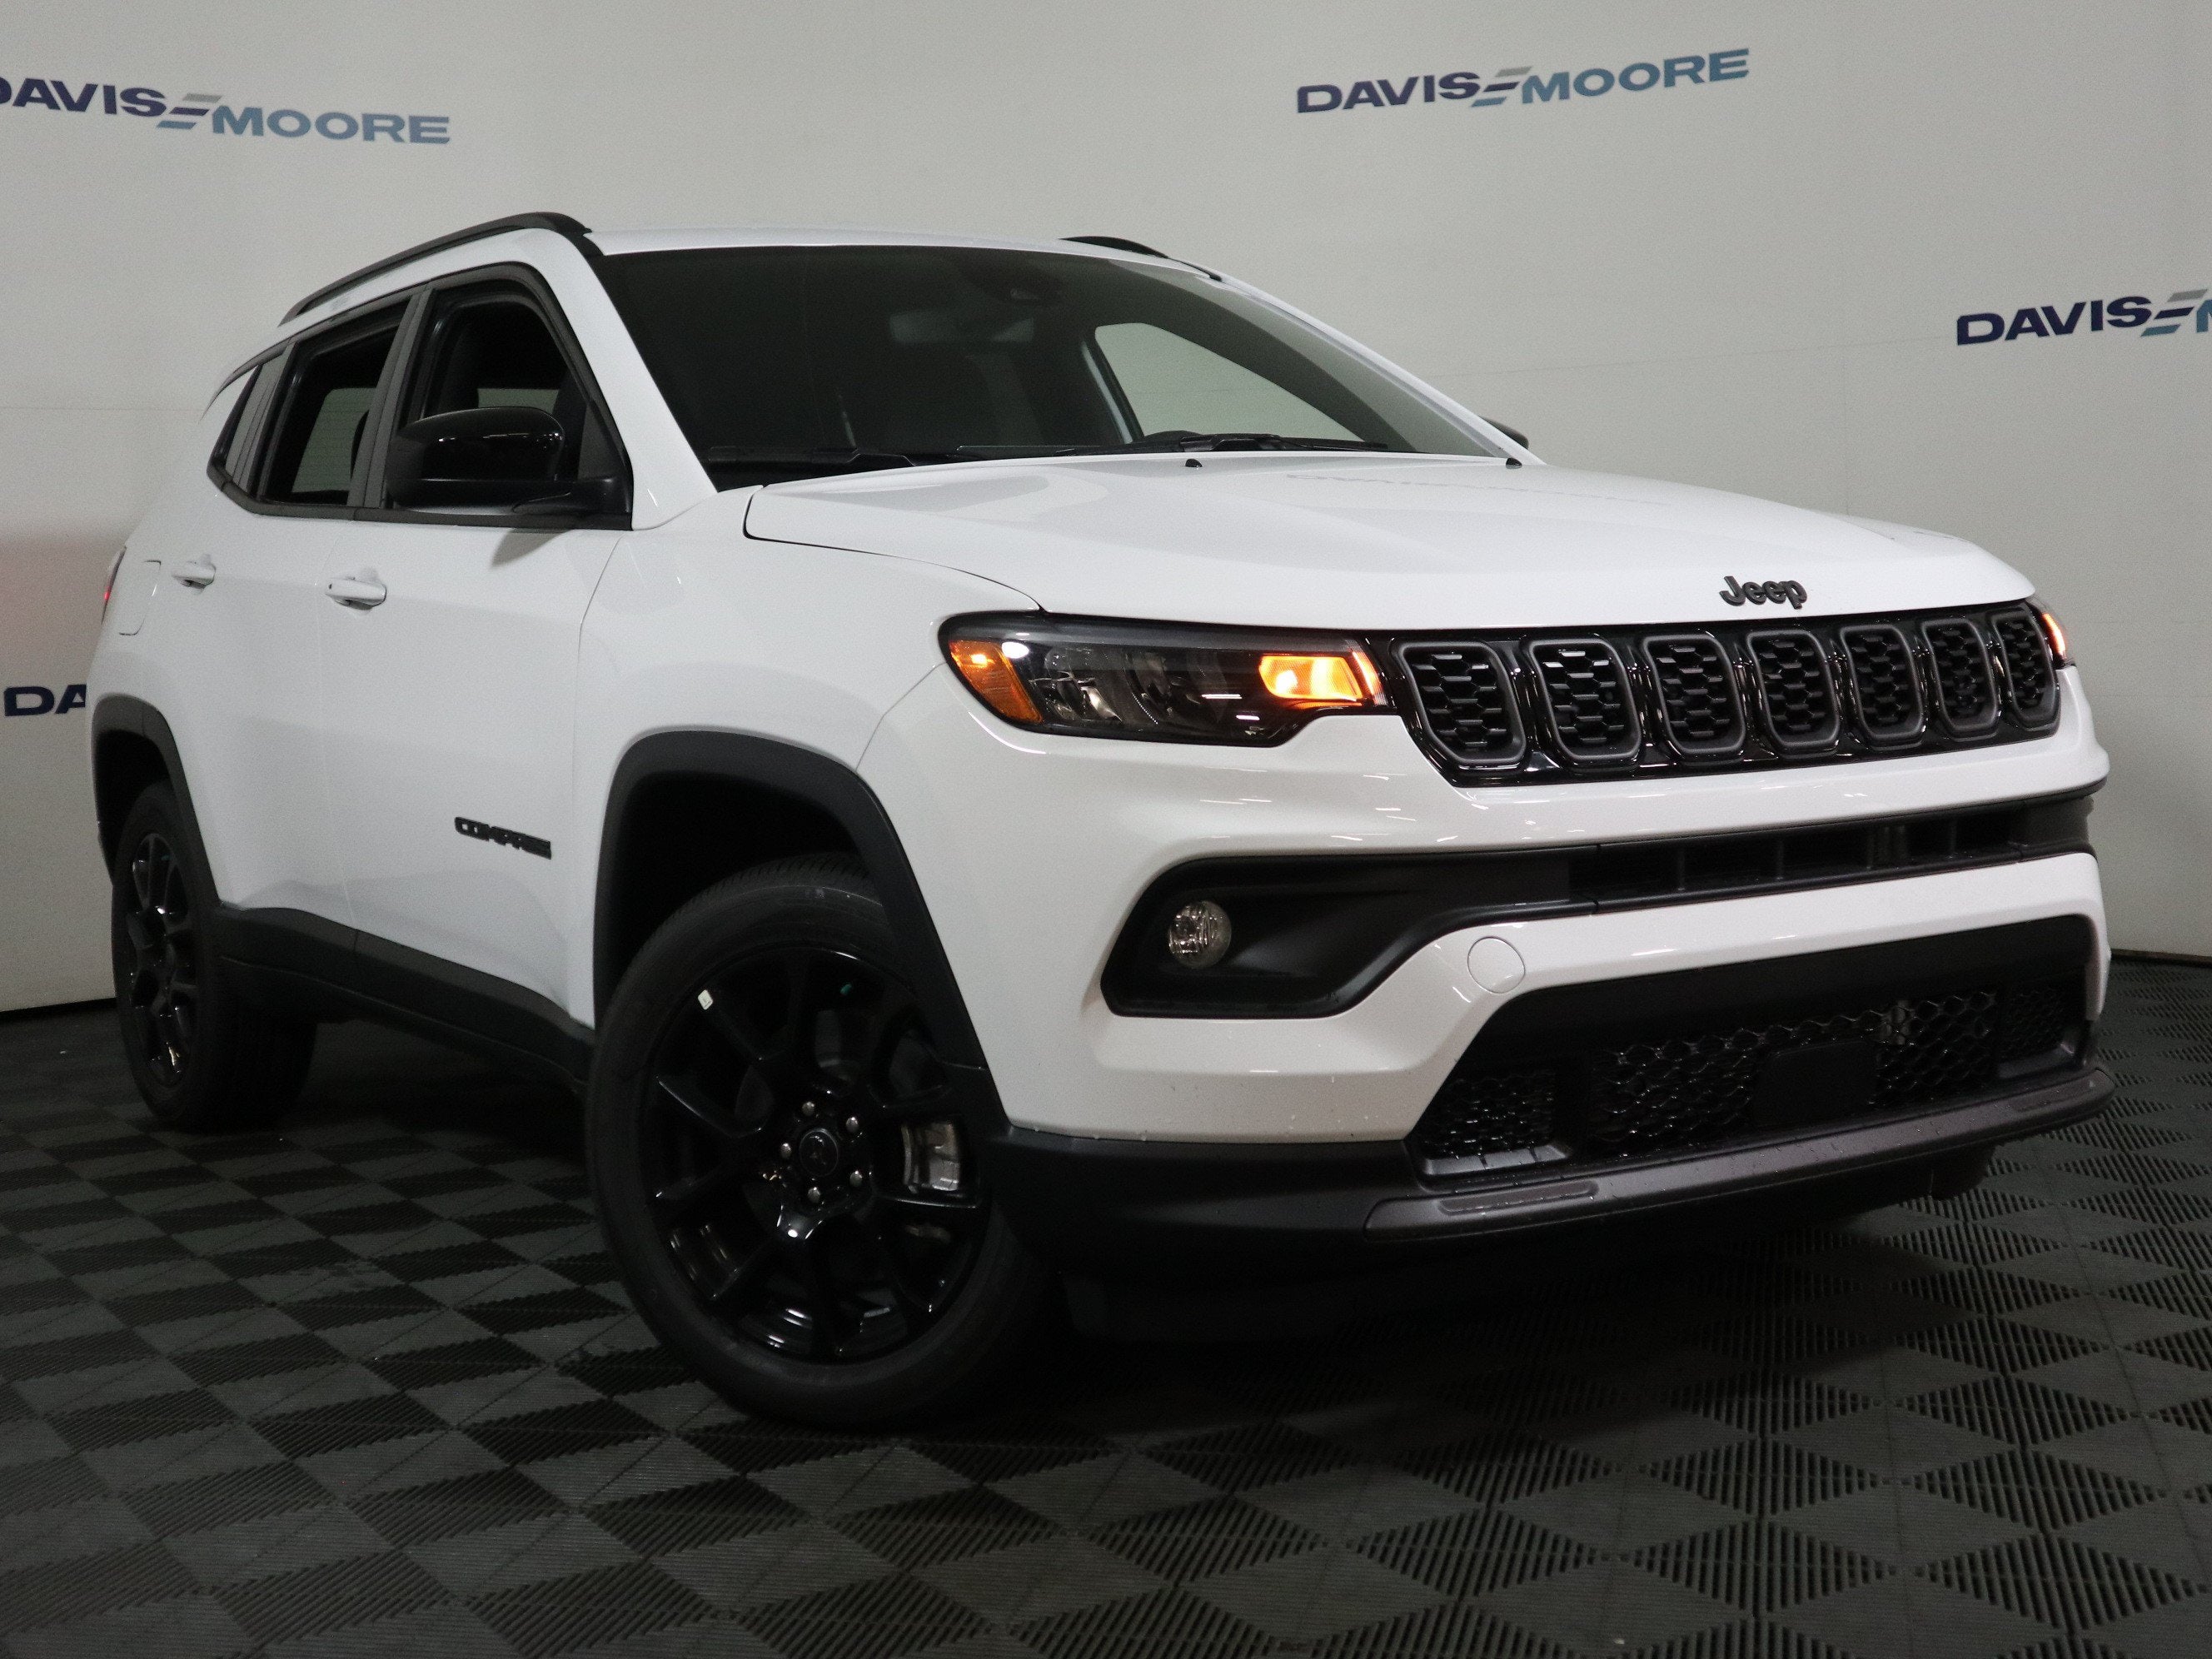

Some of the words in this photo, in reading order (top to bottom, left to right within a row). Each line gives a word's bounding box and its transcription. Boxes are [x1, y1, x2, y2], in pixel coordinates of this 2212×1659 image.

[1297, 71, 1482, 113] DAVIS
[1522, 47, 1750, 104] MOORE
[0, 77, 167, 117] AVIS
[212, 104, 451, 145] MOORE
[1956, 296, 2153, 346] DAVIS
[1719, 575, 1808, 610] Jeep
